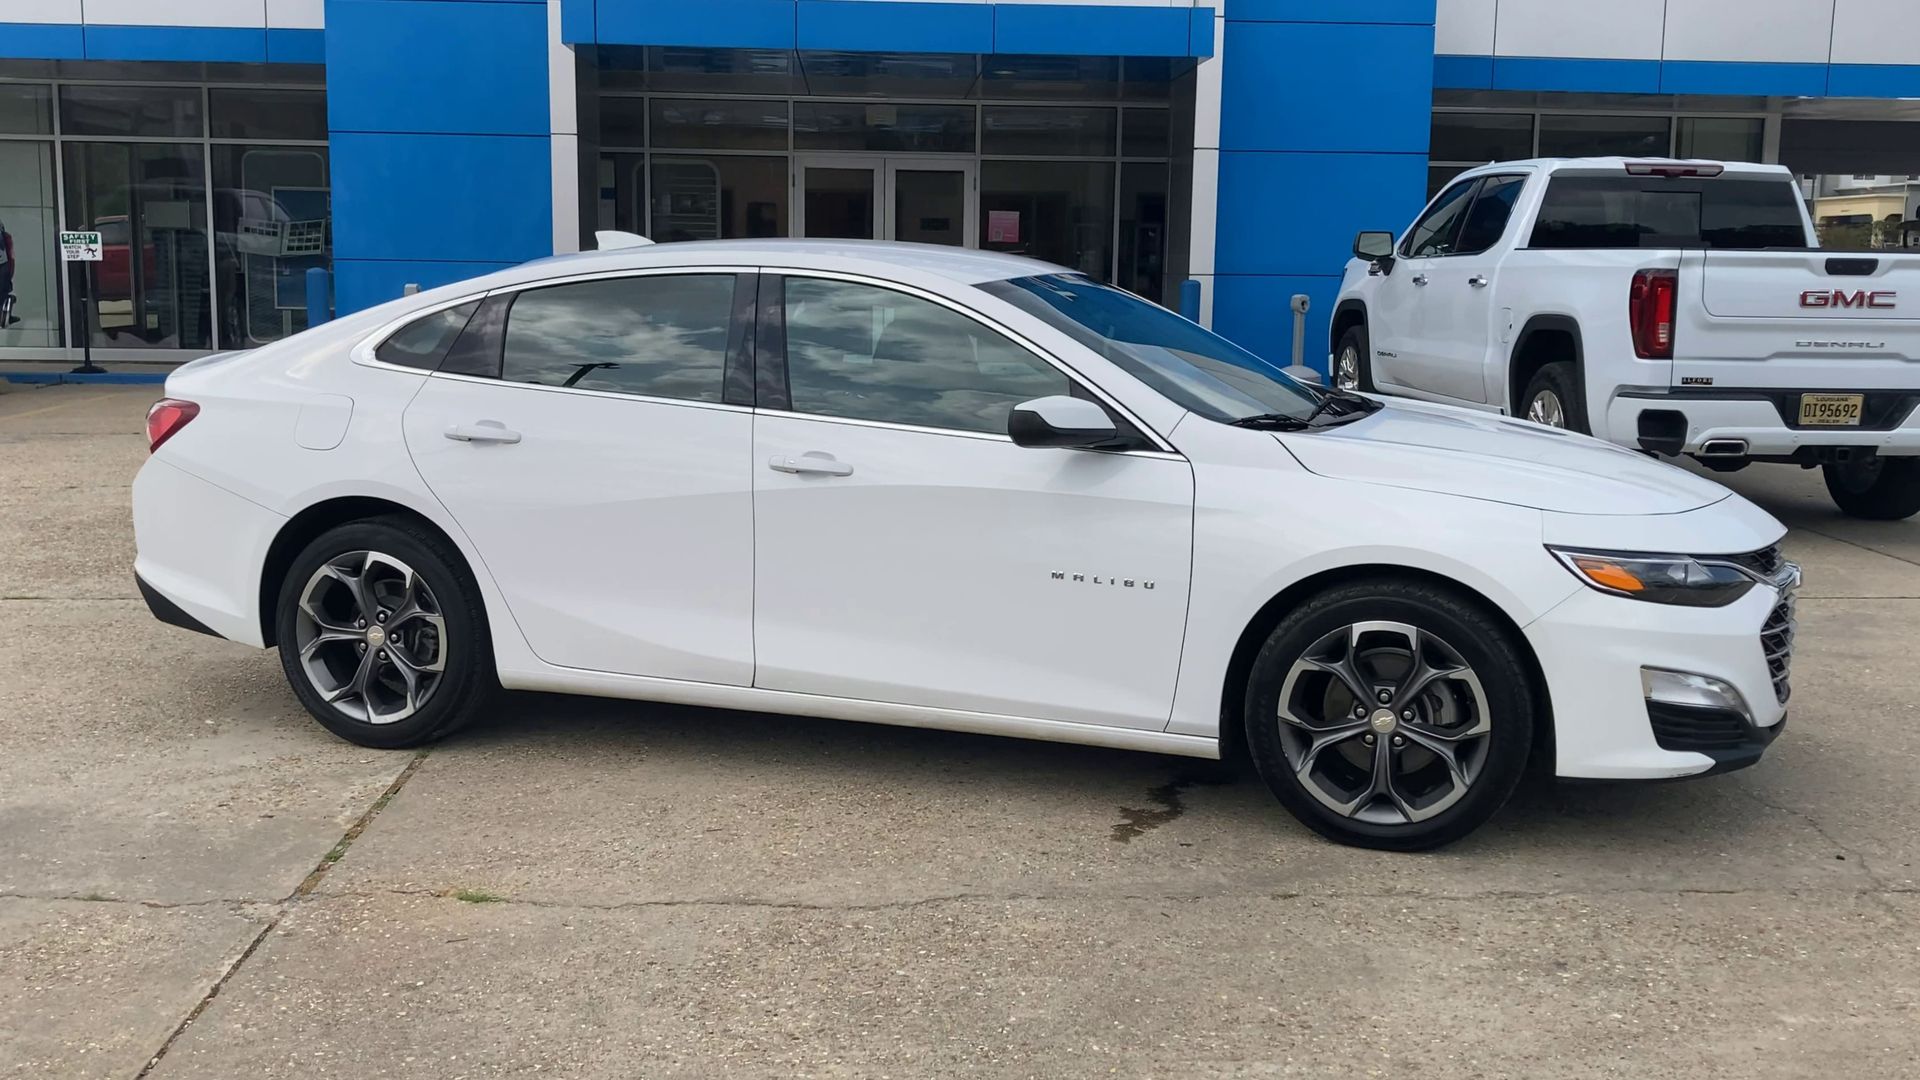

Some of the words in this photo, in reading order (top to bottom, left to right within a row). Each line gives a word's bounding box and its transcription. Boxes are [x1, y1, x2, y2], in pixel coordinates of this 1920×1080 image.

[1799, 289, 1896, 309] GMC
[1795, 341, 1885, 349] DENALI
[1804, 403, 1858, 418] DI95692
[1051, 570, 1155, 590] MALIBU
